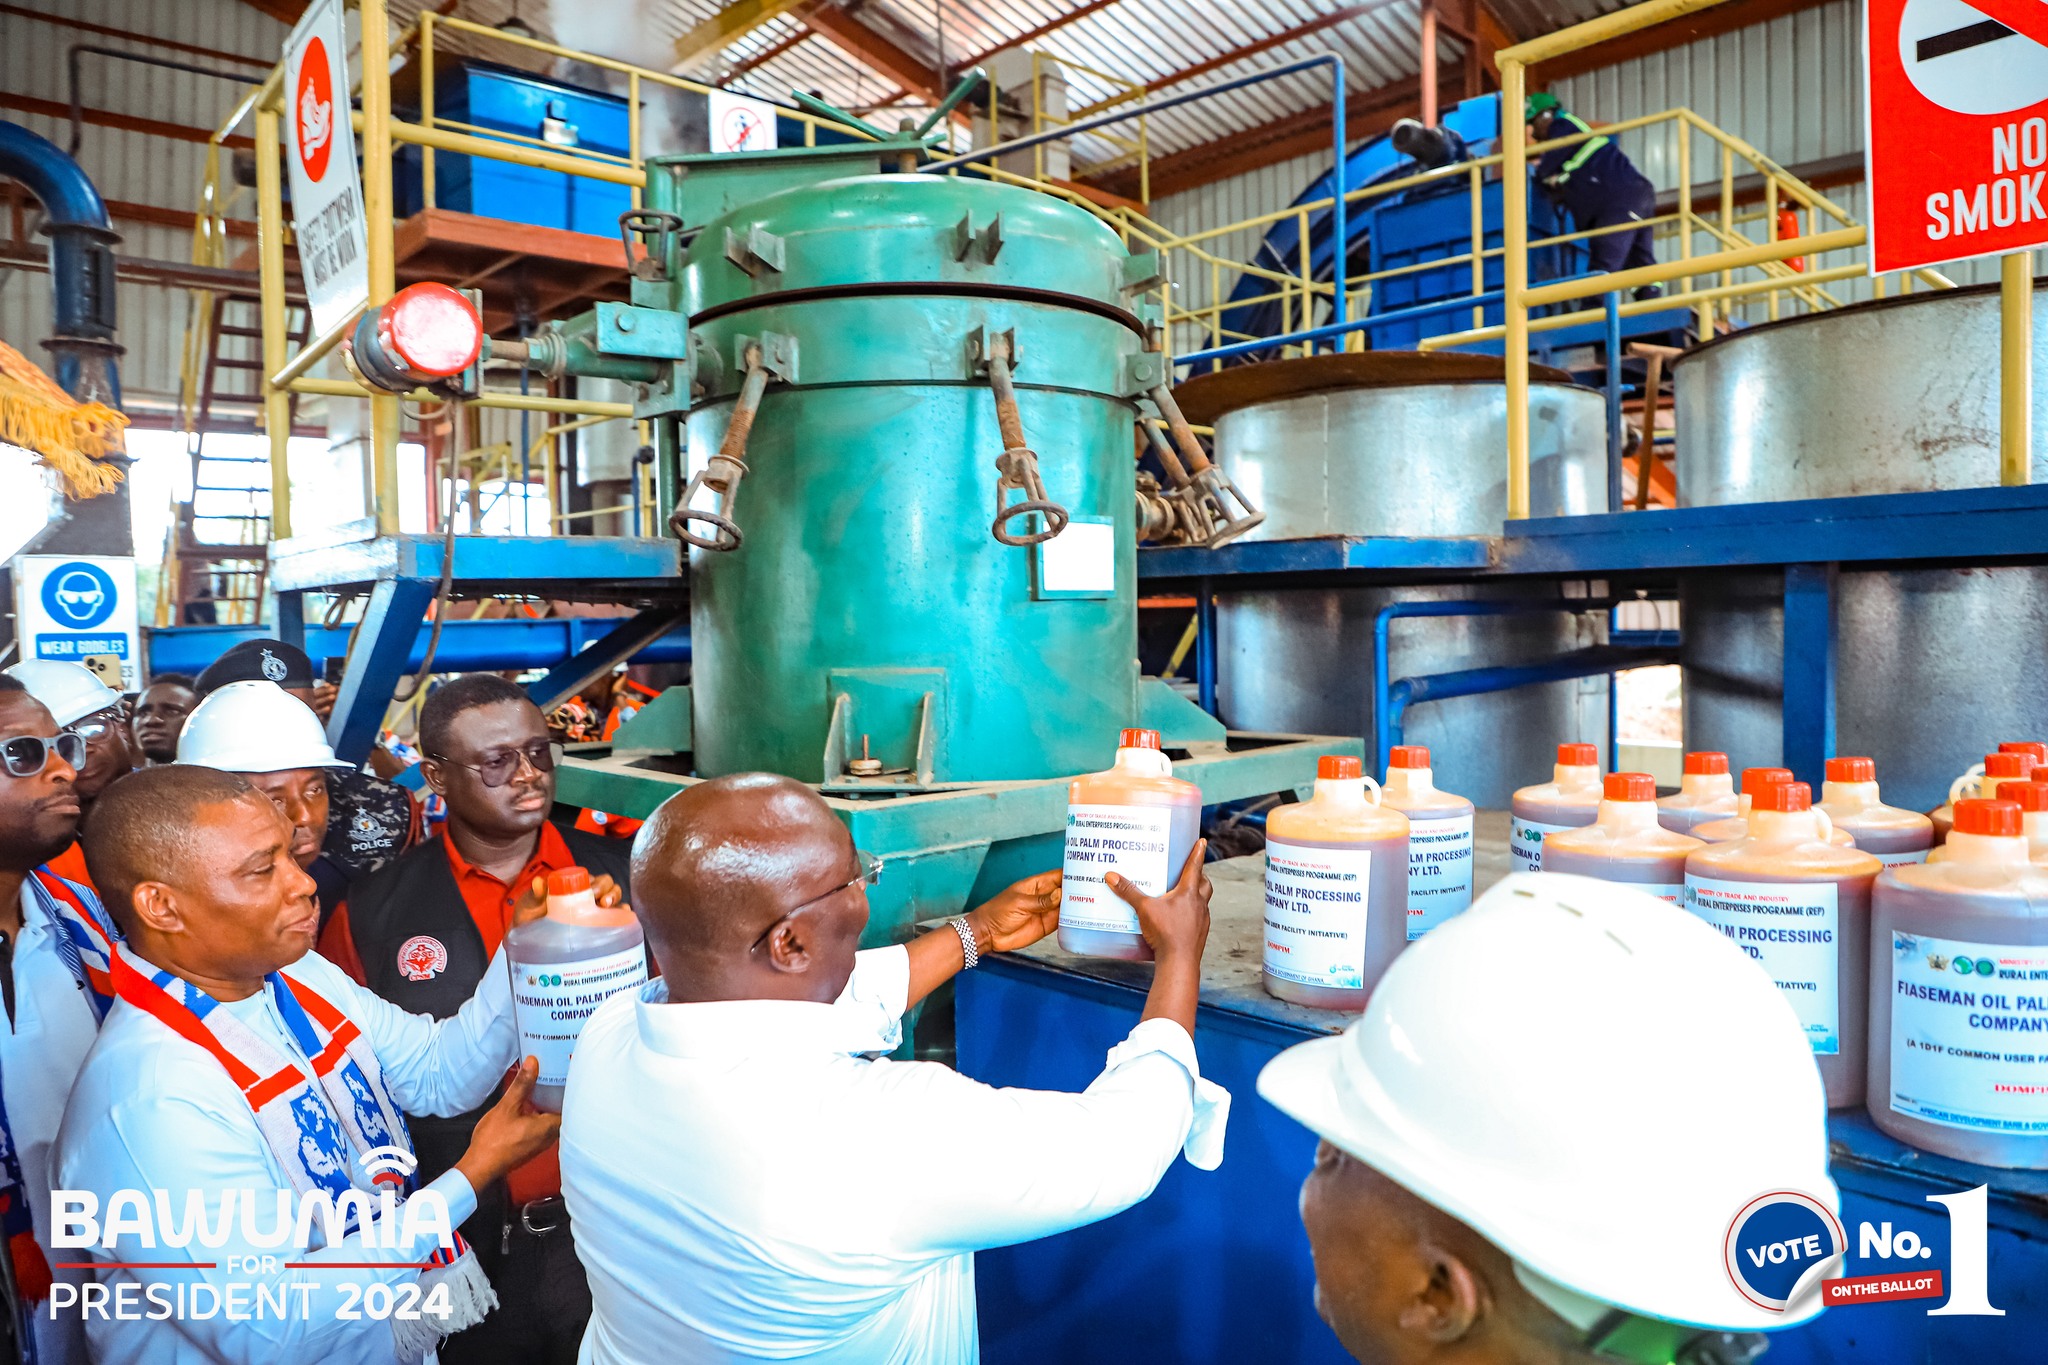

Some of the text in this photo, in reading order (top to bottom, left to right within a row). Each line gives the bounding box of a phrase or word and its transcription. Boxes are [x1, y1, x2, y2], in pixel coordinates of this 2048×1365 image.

[1992, 117, 2047, 175] NO
[1926, 170, 2048, 241] SMOK
[40, 639, 125, 655] WEAR GOGGLES
[351, 838, 393, 852] POLICE
[1079, 838, 1100, 848] PALM
[1102, 839, 1165, 853] PROCESSING
[1410, 835, 1434, 844] TERPRISES
[1097, 852, 1118, 864] LTD.
[1410, 847, 1471, 863] LM PROCESSING
[1305, 870, 1341, 881] PROGRAMME
[1422, 866, 1442, 876] LTD.
[1274, 882, 1293, 896] PALM
[1295, 887, 1361, 902] PROCESSING
[1411, 889, 1438, 897] FACILITY
[1291, 901, 1311, 914] LTD.
[1712, 900, 1751, 913] ENTERPRISES
[1752, 904, 1804, 916] PROGRAMME
[1805, 906, 1825, 917] (REP)
[1281, 924, 1306, 935] FACILITY
[1308, 929, 1348, 940] INITIATIVE)
[1739, 926, 1832, 943] PROCESSING
[1999, 969, 2026, 980] RURAL
[556, 995, 573, 1007] OIL
[576, 992, 603, 1005] PALM
[1898, 980, 2048, 1012] FIASEMAN OIL PAL
[551, 1008, 596, 1021] COMPAN
[1906, 1038, 1916, 1048] (A
[1919, 1041, 1944, 1053] 1D1F
[1947, 1047, 2000, 1062] COMMON
[2004, 1053, 2035, 1063] USER
